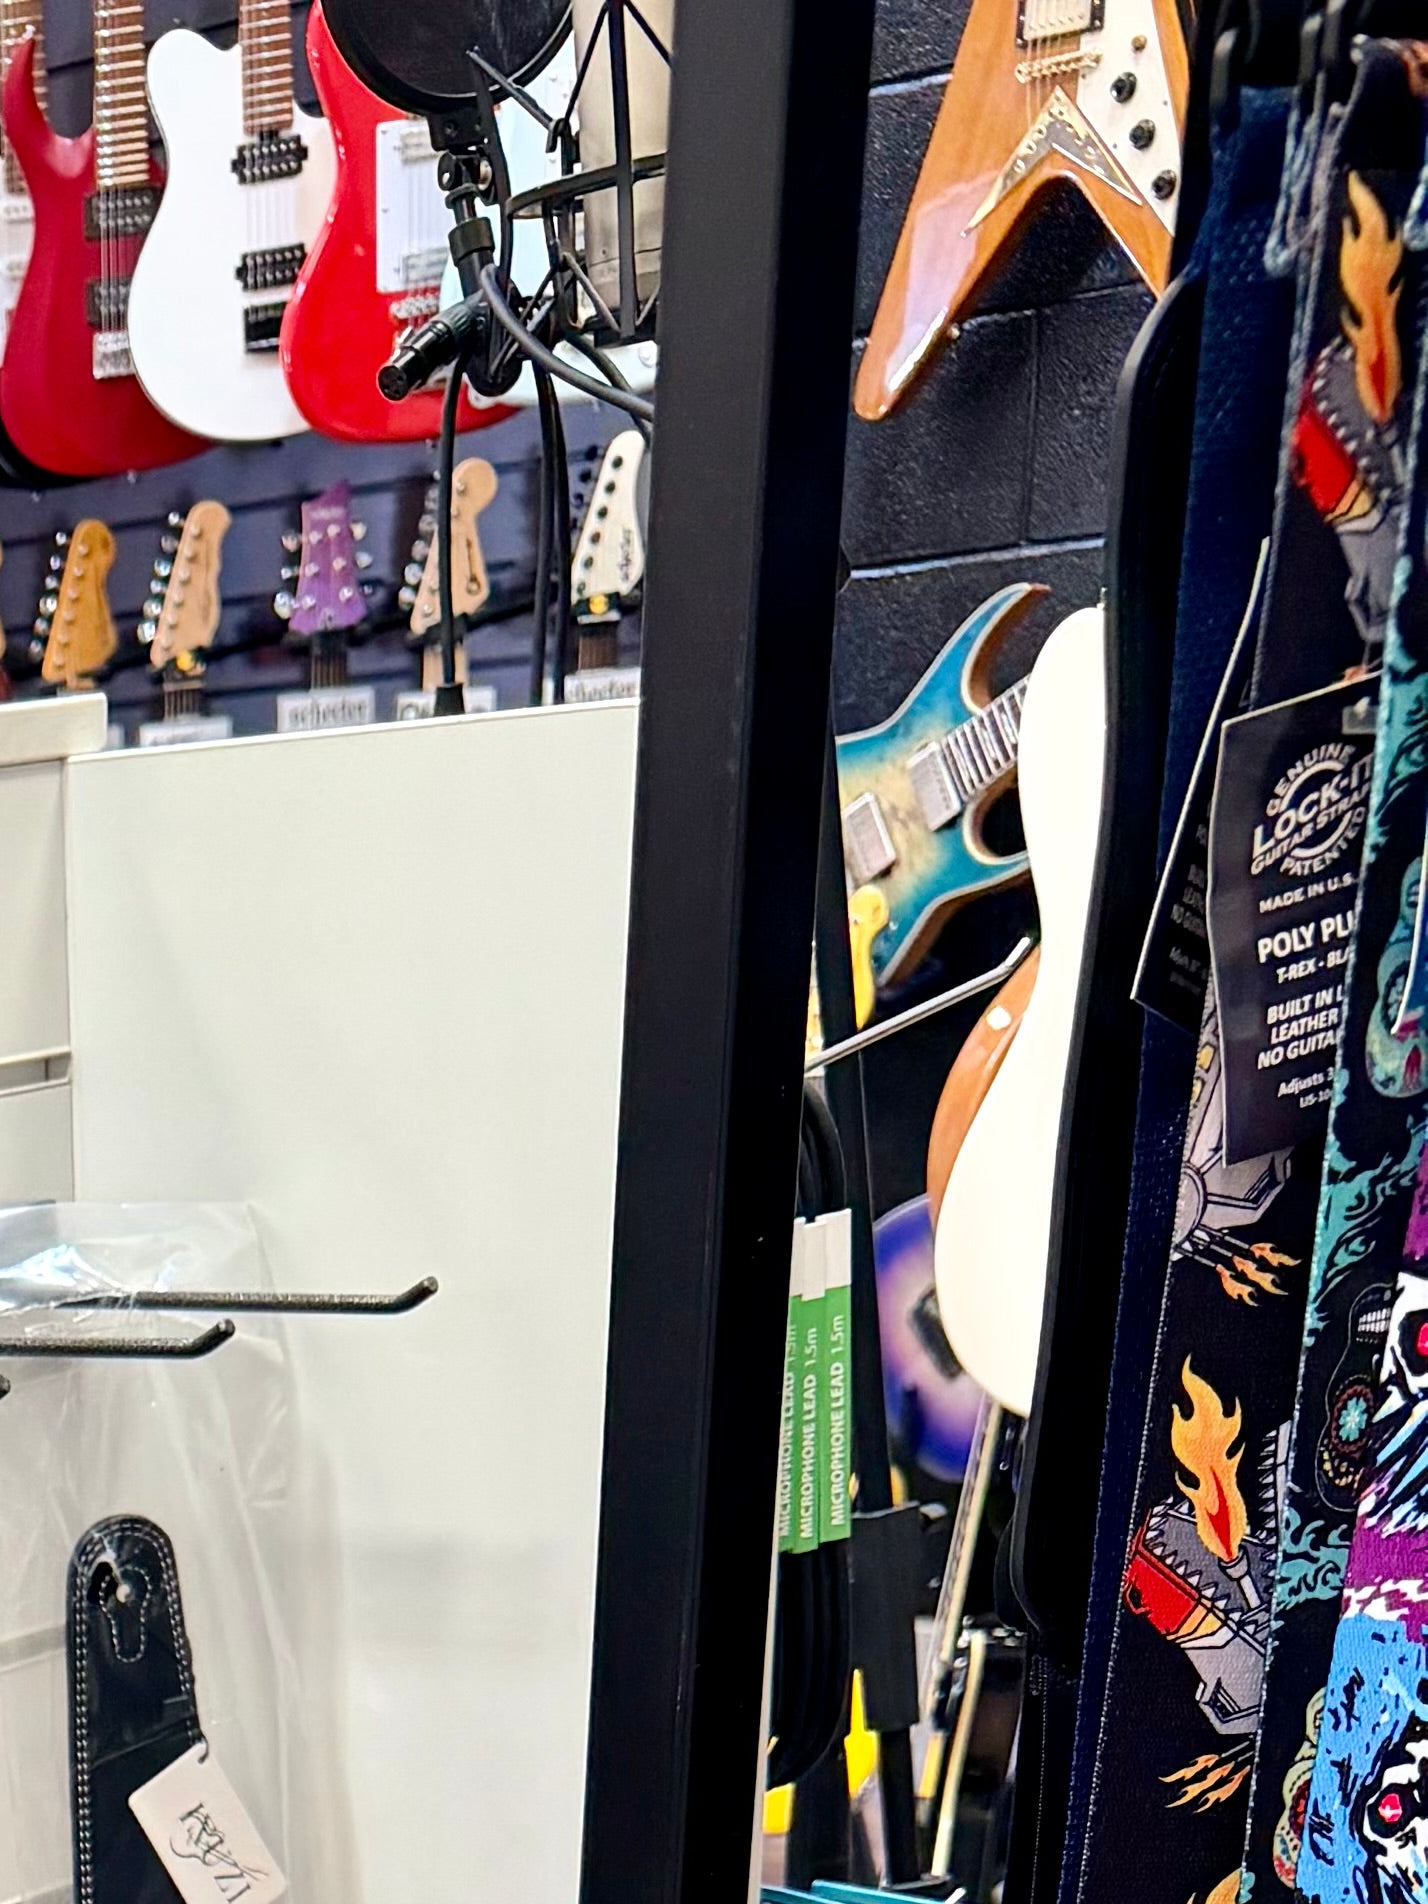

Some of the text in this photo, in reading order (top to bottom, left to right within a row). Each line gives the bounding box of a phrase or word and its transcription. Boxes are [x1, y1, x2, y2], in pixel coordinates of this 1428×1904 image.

[1266, 743, 1357, 816] GENUINE
[1251, 822, 1315, 875] GUITAR
[1280, 806, 1367, 877] PATENTED
[1259, 888, 1306, 914] MADE
[1308, 882, 1325, 898] IN
[1258, 921, 1317, 963] POLY
[1277, 961, 1315, 984] T-REX
[1267, 994, 1313, 1025] BUILT
[1315, 988, 1332, 1008] IN
[1271, 1008, 1339, 1045] LEATHER
[1257, 1031, 1338, 1070] NO GUITA
[1278, 1072, 1326, 1098] Adjusts
[800, 1327, 817, 1539] MICROPHONE LEAD 1.5m
[830, 1313, 845, 1526] MICROPHONE LEAD 1.5m
